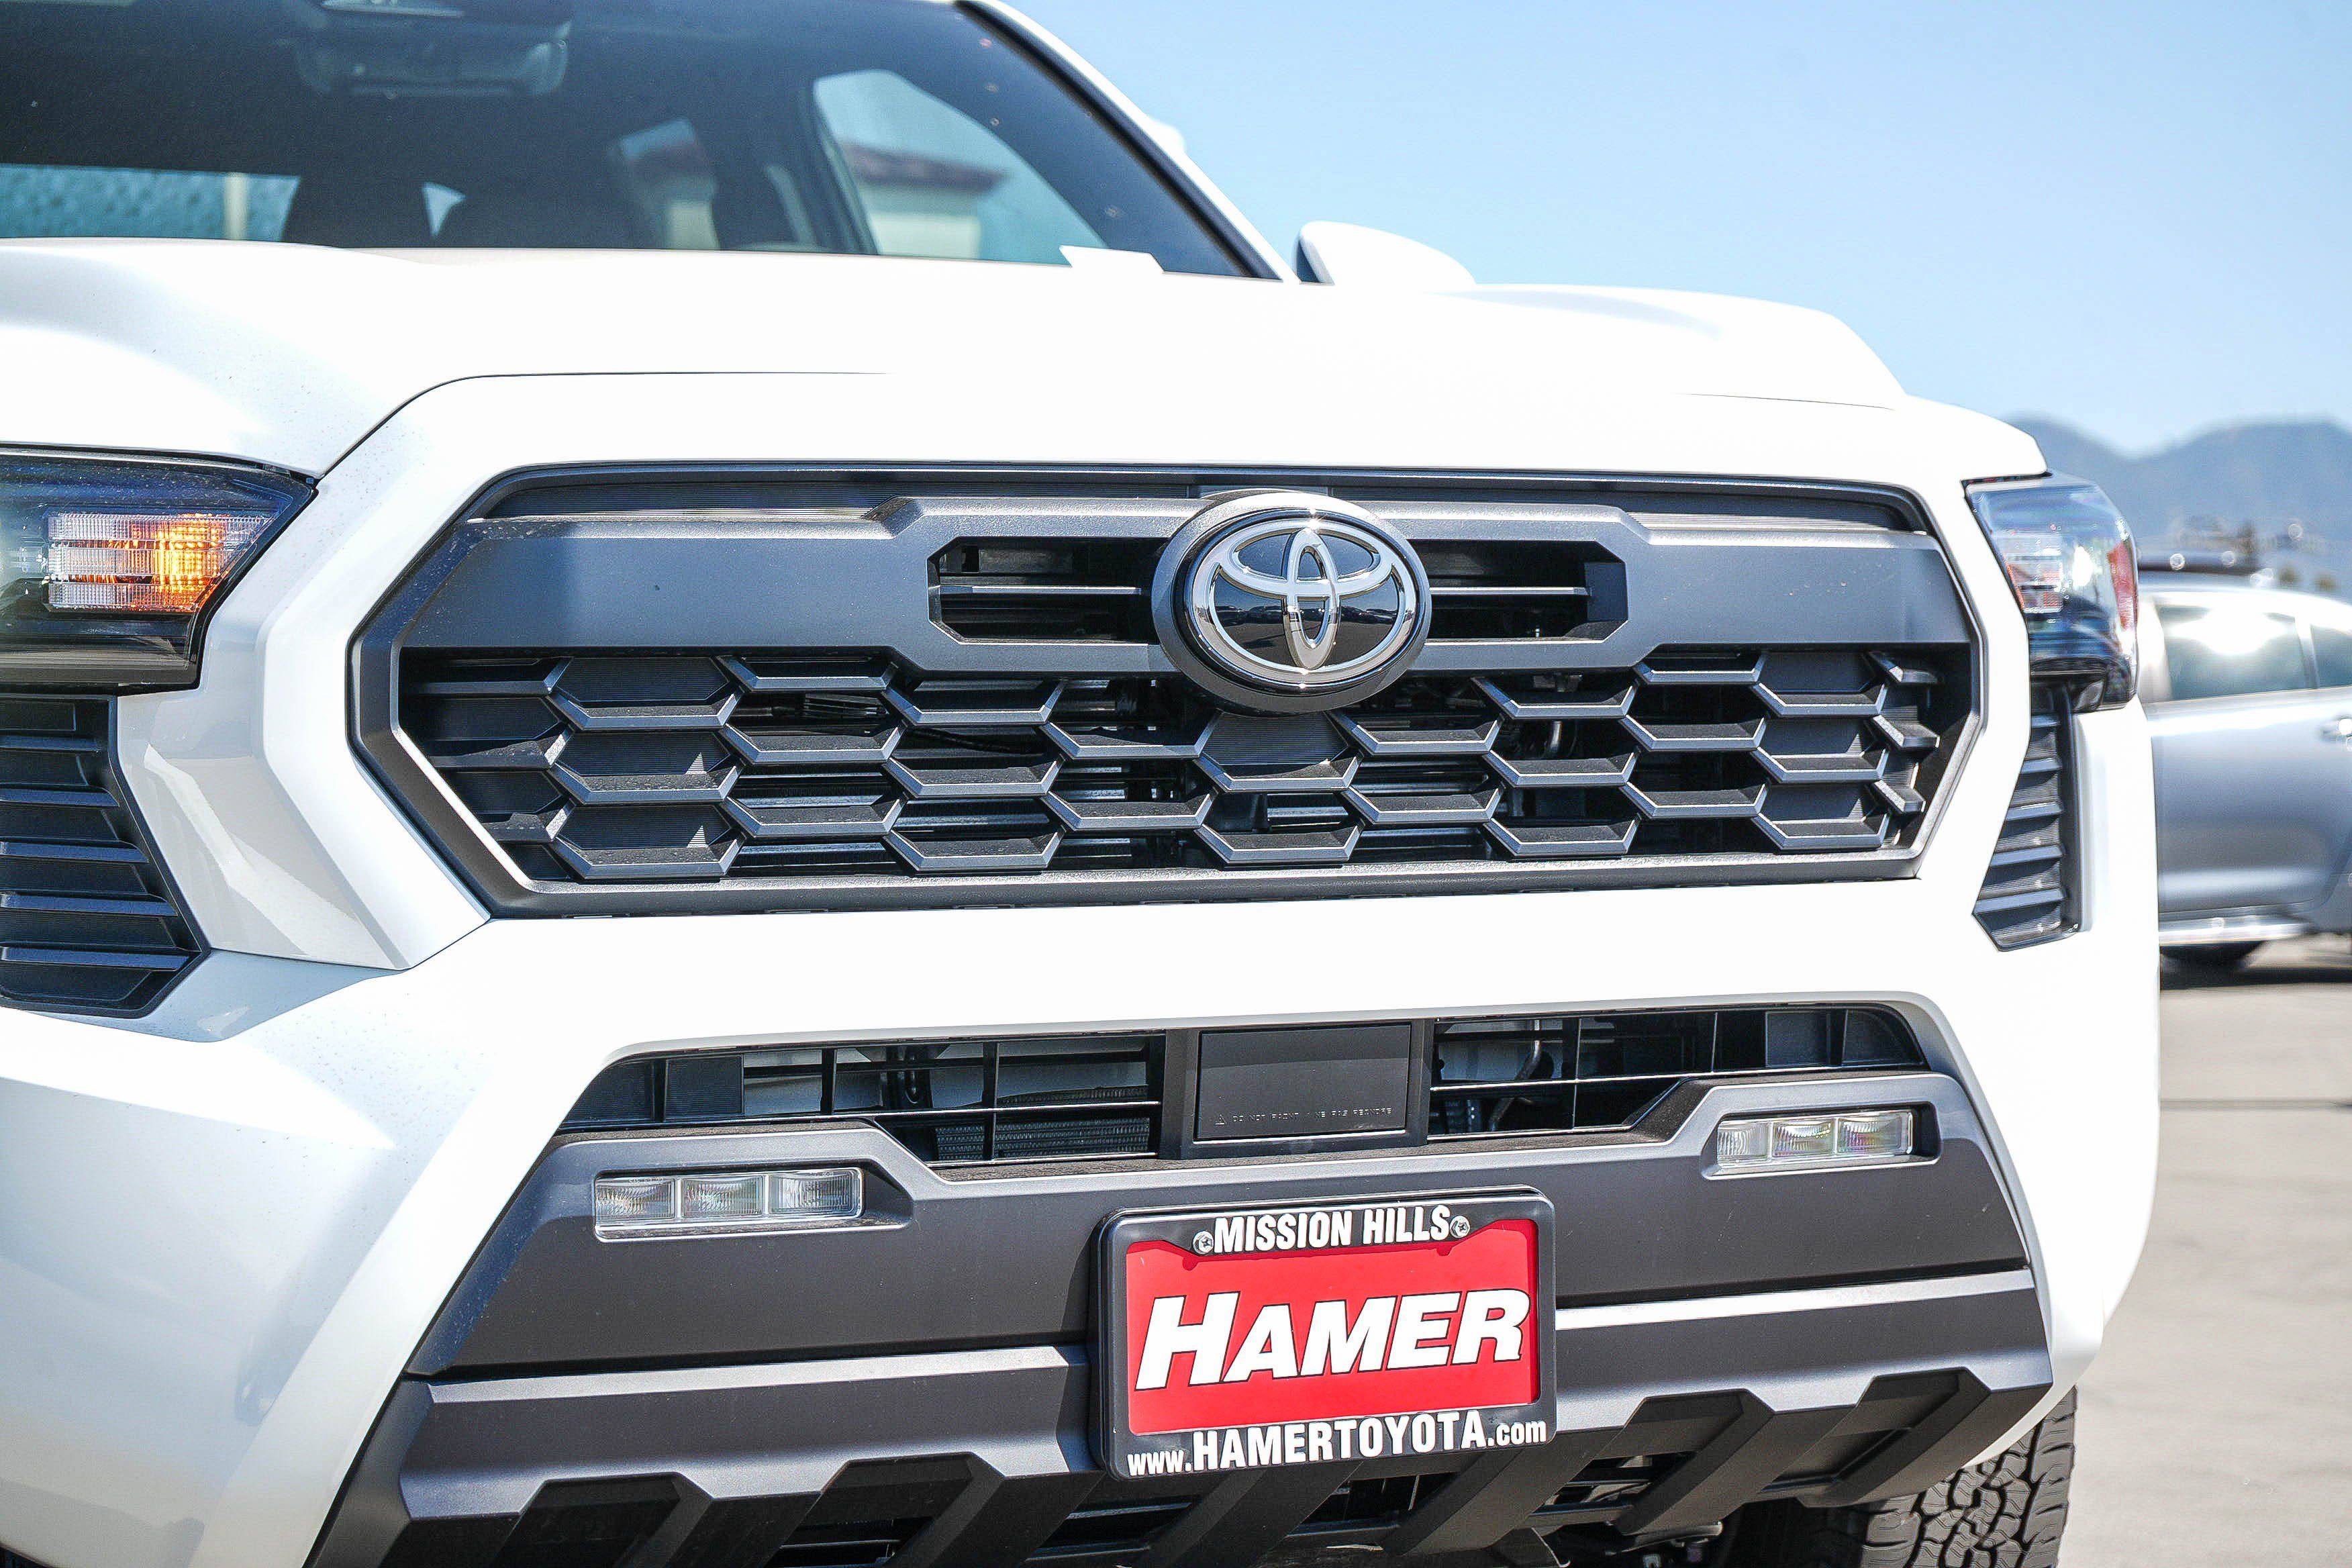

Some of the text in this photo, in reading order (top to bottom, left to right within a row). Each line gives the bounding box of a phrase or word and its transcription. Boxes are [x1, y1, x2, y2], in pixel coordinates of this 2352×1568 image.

[1214, 1204, 1451, 1253] MISSION HILLS
[1134, 1288, 1531, 1391] HAMER
[1127, 1410, 1547, 1477] www.HAMERTOYOTA.com
